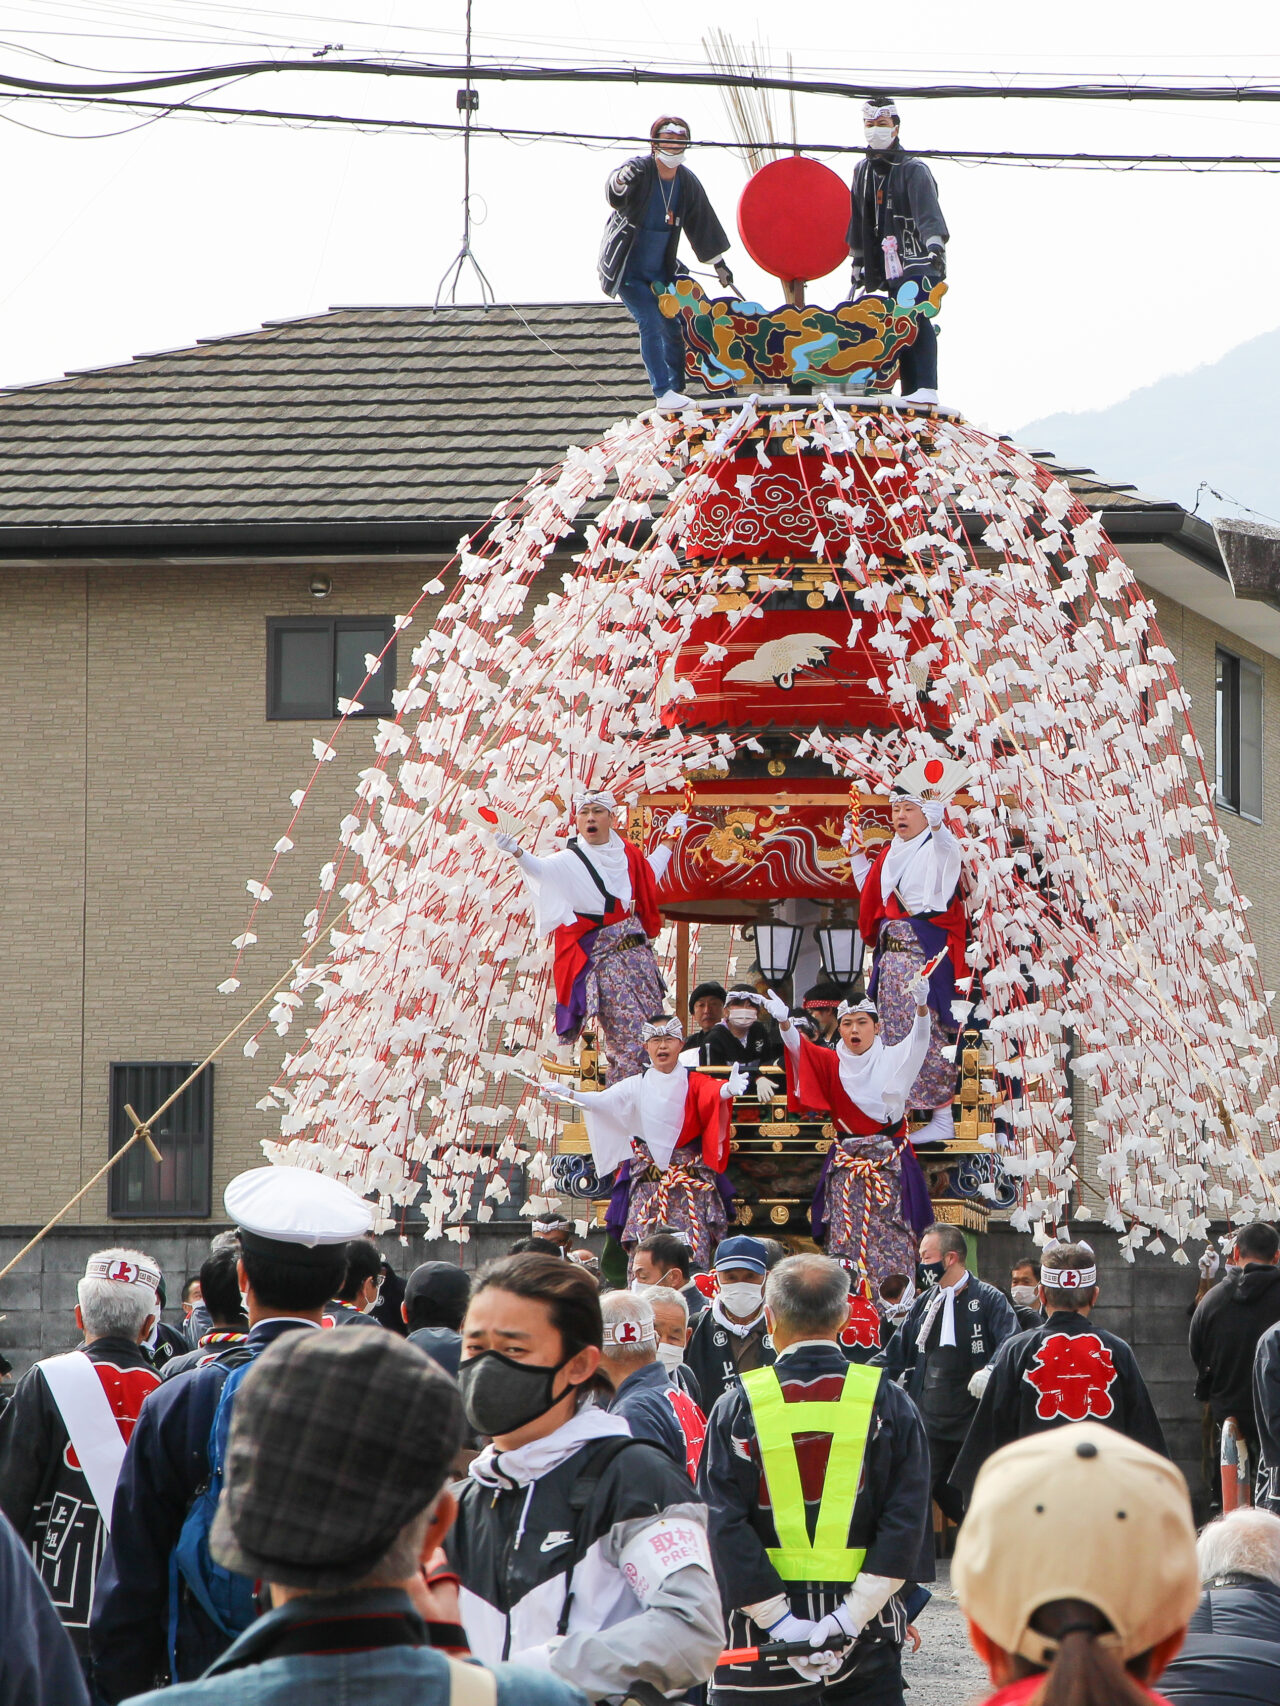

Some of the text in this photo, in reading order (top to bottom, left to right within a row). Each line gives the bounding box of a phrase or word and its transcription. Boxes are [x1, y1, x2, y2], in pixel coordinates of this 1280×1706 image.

[112, 1261, 132, 1282] 上
[1063, 1271, 1076, 1286] 上
[619, 1323, 637, 1342] 上
[970, 1323, 985, 1354] 上組
[1022, 1332, 1118, 1422] 祭
[661, 1545, 702, 1567] PRE
